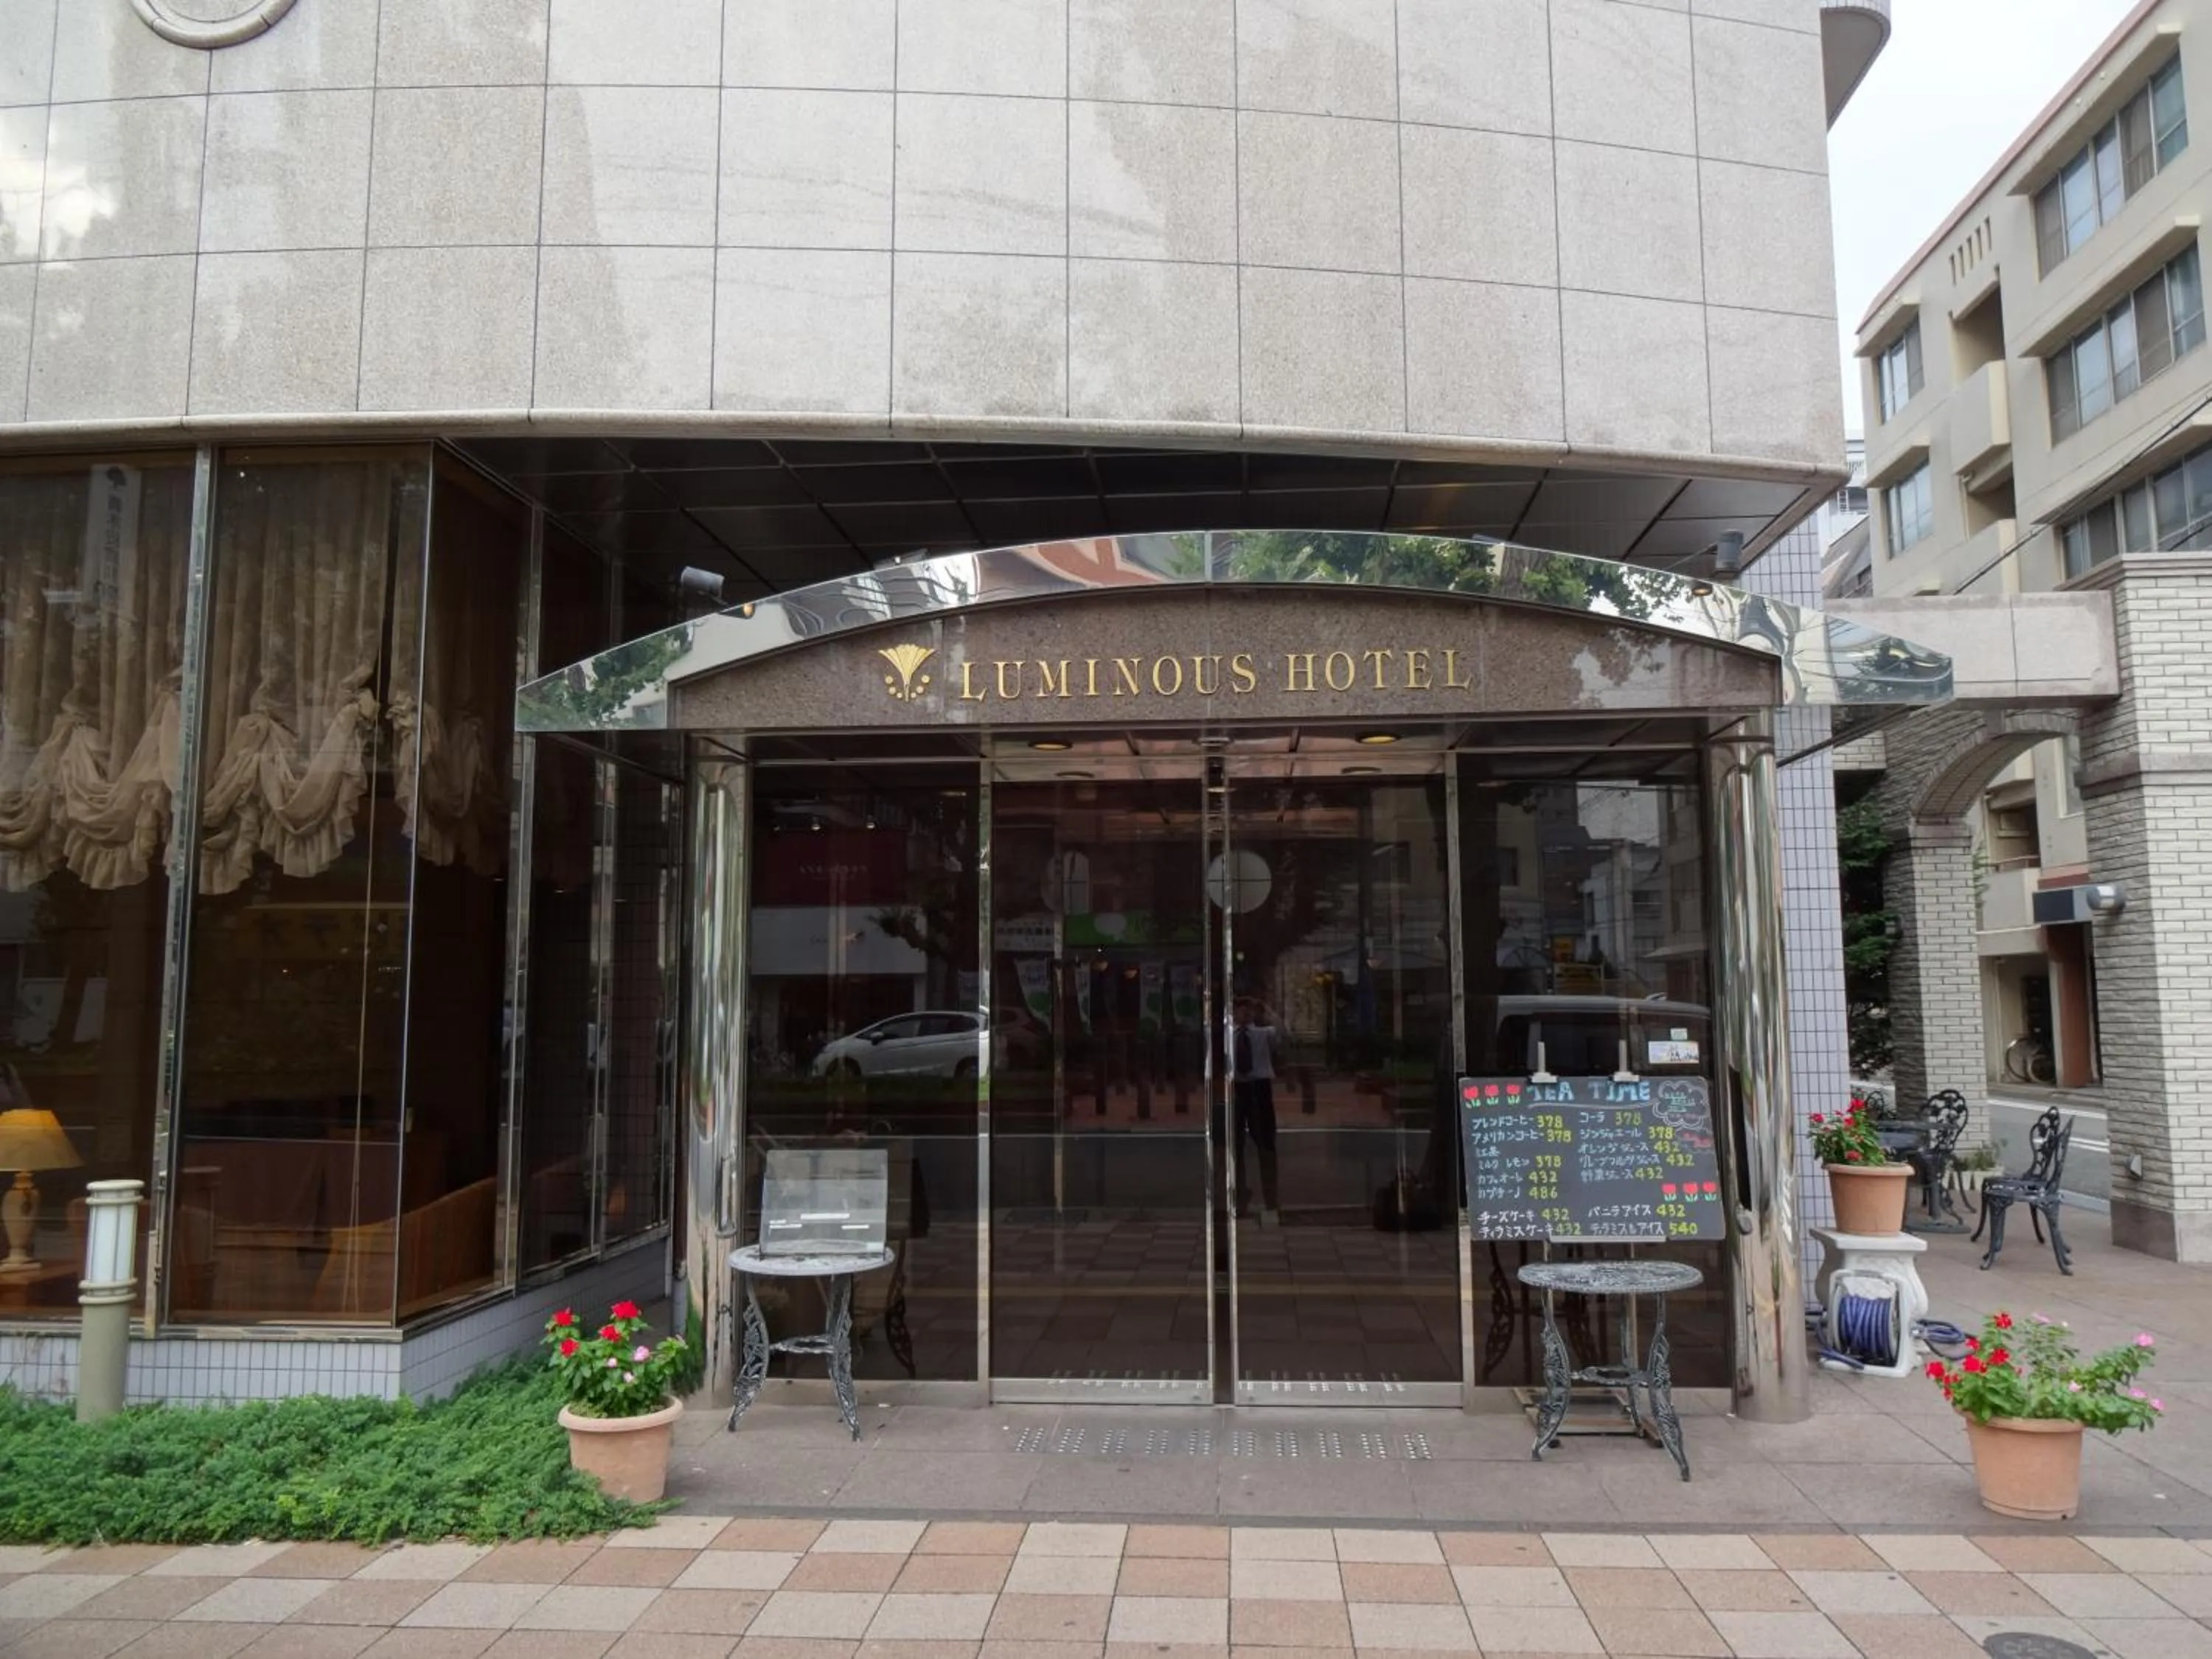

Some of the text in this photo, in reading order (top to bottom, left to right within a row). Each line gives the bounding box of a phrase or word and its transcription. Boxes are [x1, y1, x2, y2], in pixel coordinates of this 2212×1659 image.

[959, 648, 1472, 700] LUMINOUS HOTEL
[1526, 1080, 1651, 1102] TEA TIME
[1536, 1114, 1564, 1129] 378
[1579, 1110, 1642, 1126] コーラ 378
[1471, 1128, 1572, 1144] アメリカンコーヒー 378
[1648, 1126, 1676, 1140] 378
[1653, 1140, 1681, 1154] 432
[1535, 1155, 1562, 1168] 378
[1666, 1153, 1695, 1167] 432
[1528, 1170, 1558, 1184] 432
[1634, 1166, 1664, 1181] 432
[1528, 1186, 1558, 1200] 486
[1477, 1207, 1571, 1225] チーズケーキ 432
[1655, 1203, 1686, 1217] 432
[1478, 1221, 1582, 1239] ティラミスケーキ 432
[1669, 1222, 1698, 1236] 540
